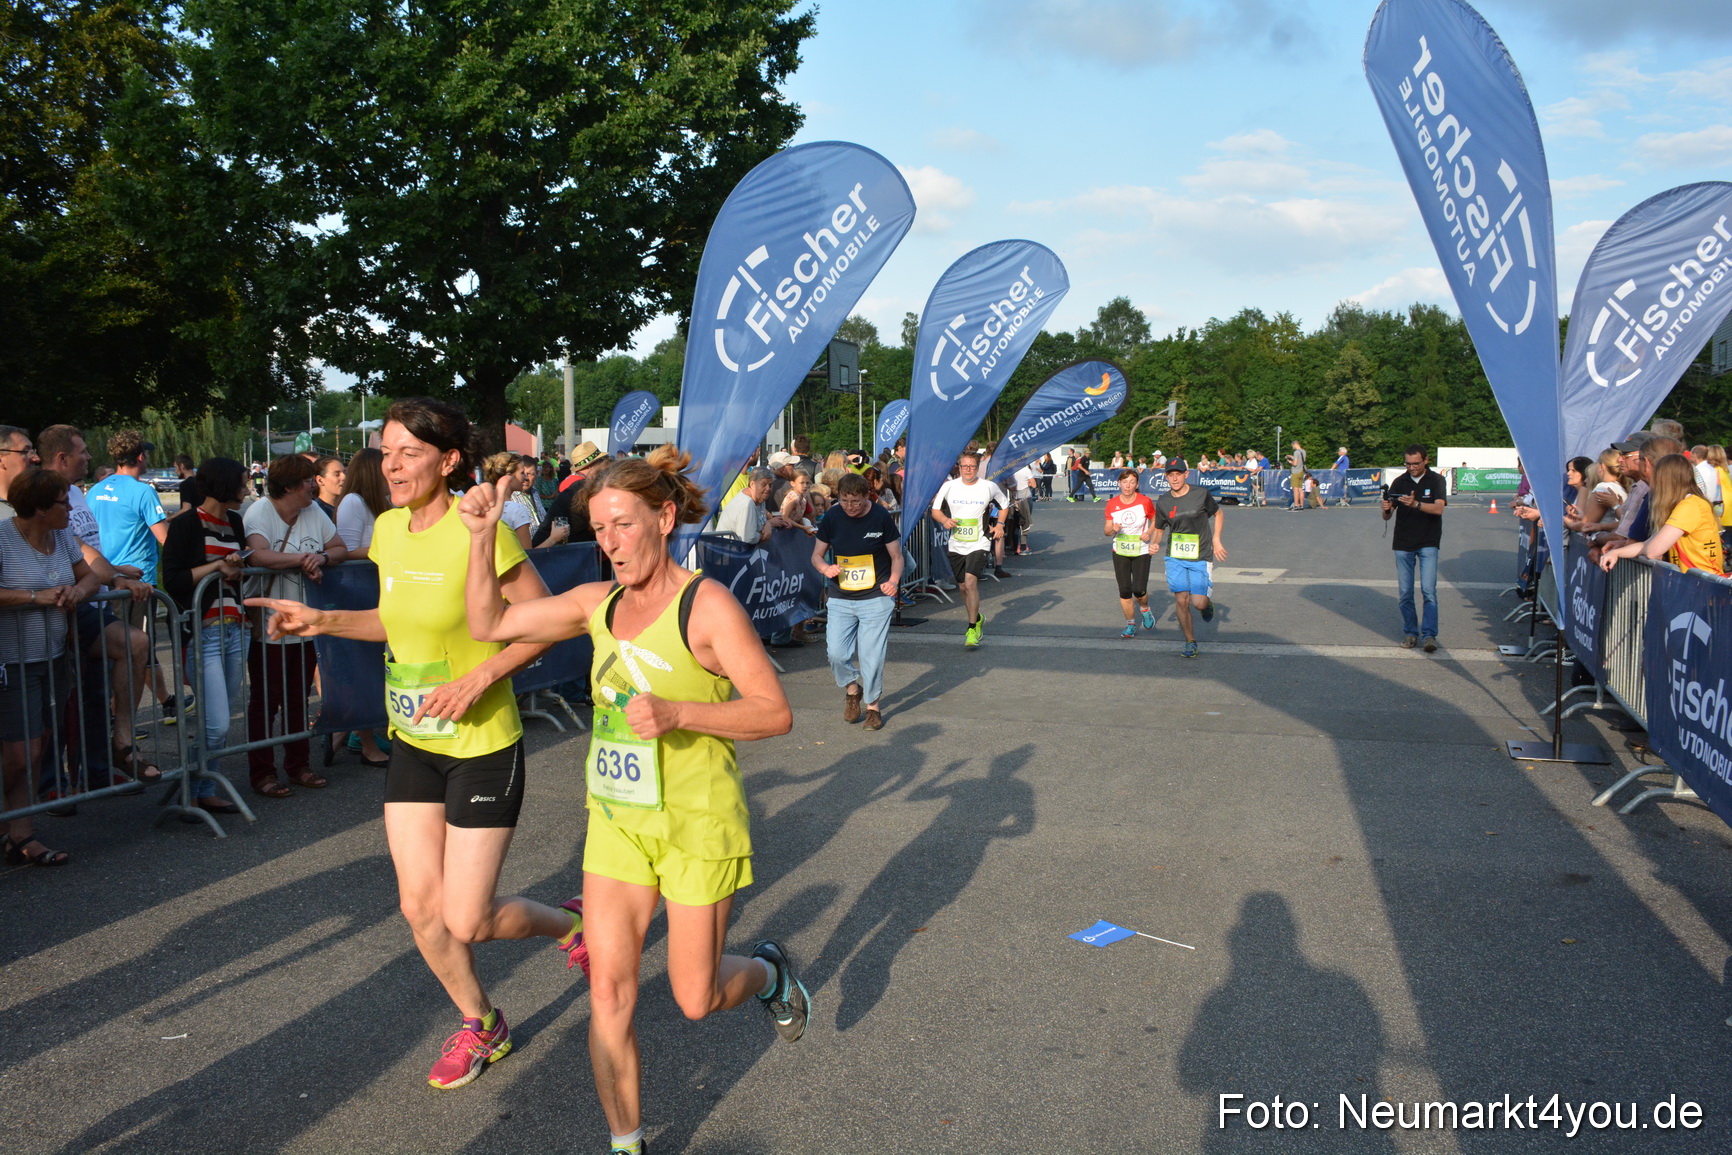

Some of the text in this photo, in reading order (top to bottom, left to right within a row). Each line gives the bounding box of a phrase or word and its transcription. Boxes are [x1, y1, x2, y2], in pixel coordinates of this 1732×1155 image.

[745, 182, 868, 344] Fischer
[787, 214, 880, 344] AUTOMOBILE
[1614, 214, 1732, 363] Fischer
[951, 265, 1035, 381] Fischer
[980, 286, 1045, 379] AUTOMOBILE
[621, 398, 649, 436] Fischer
[885, 405, 908, 436] Fischer
[1008, 397, 1094, 448] Frischmann
[1063, 413, 1084, 427] Druck
[1097, 391, 1122, 409] Medien
[1200, 477, 1236, 486] Frischmann
[1461, 472, 1478, 484] AOK
[957, 527, 974, 536] 280
[1120, 542, 1135, 551] 541
[1174, 542, 1196, 552] 1487
[746, 570, 804, 604] Fischer
[844, 569, 867, 581] 767
[597, 747, 641, 782] 636
